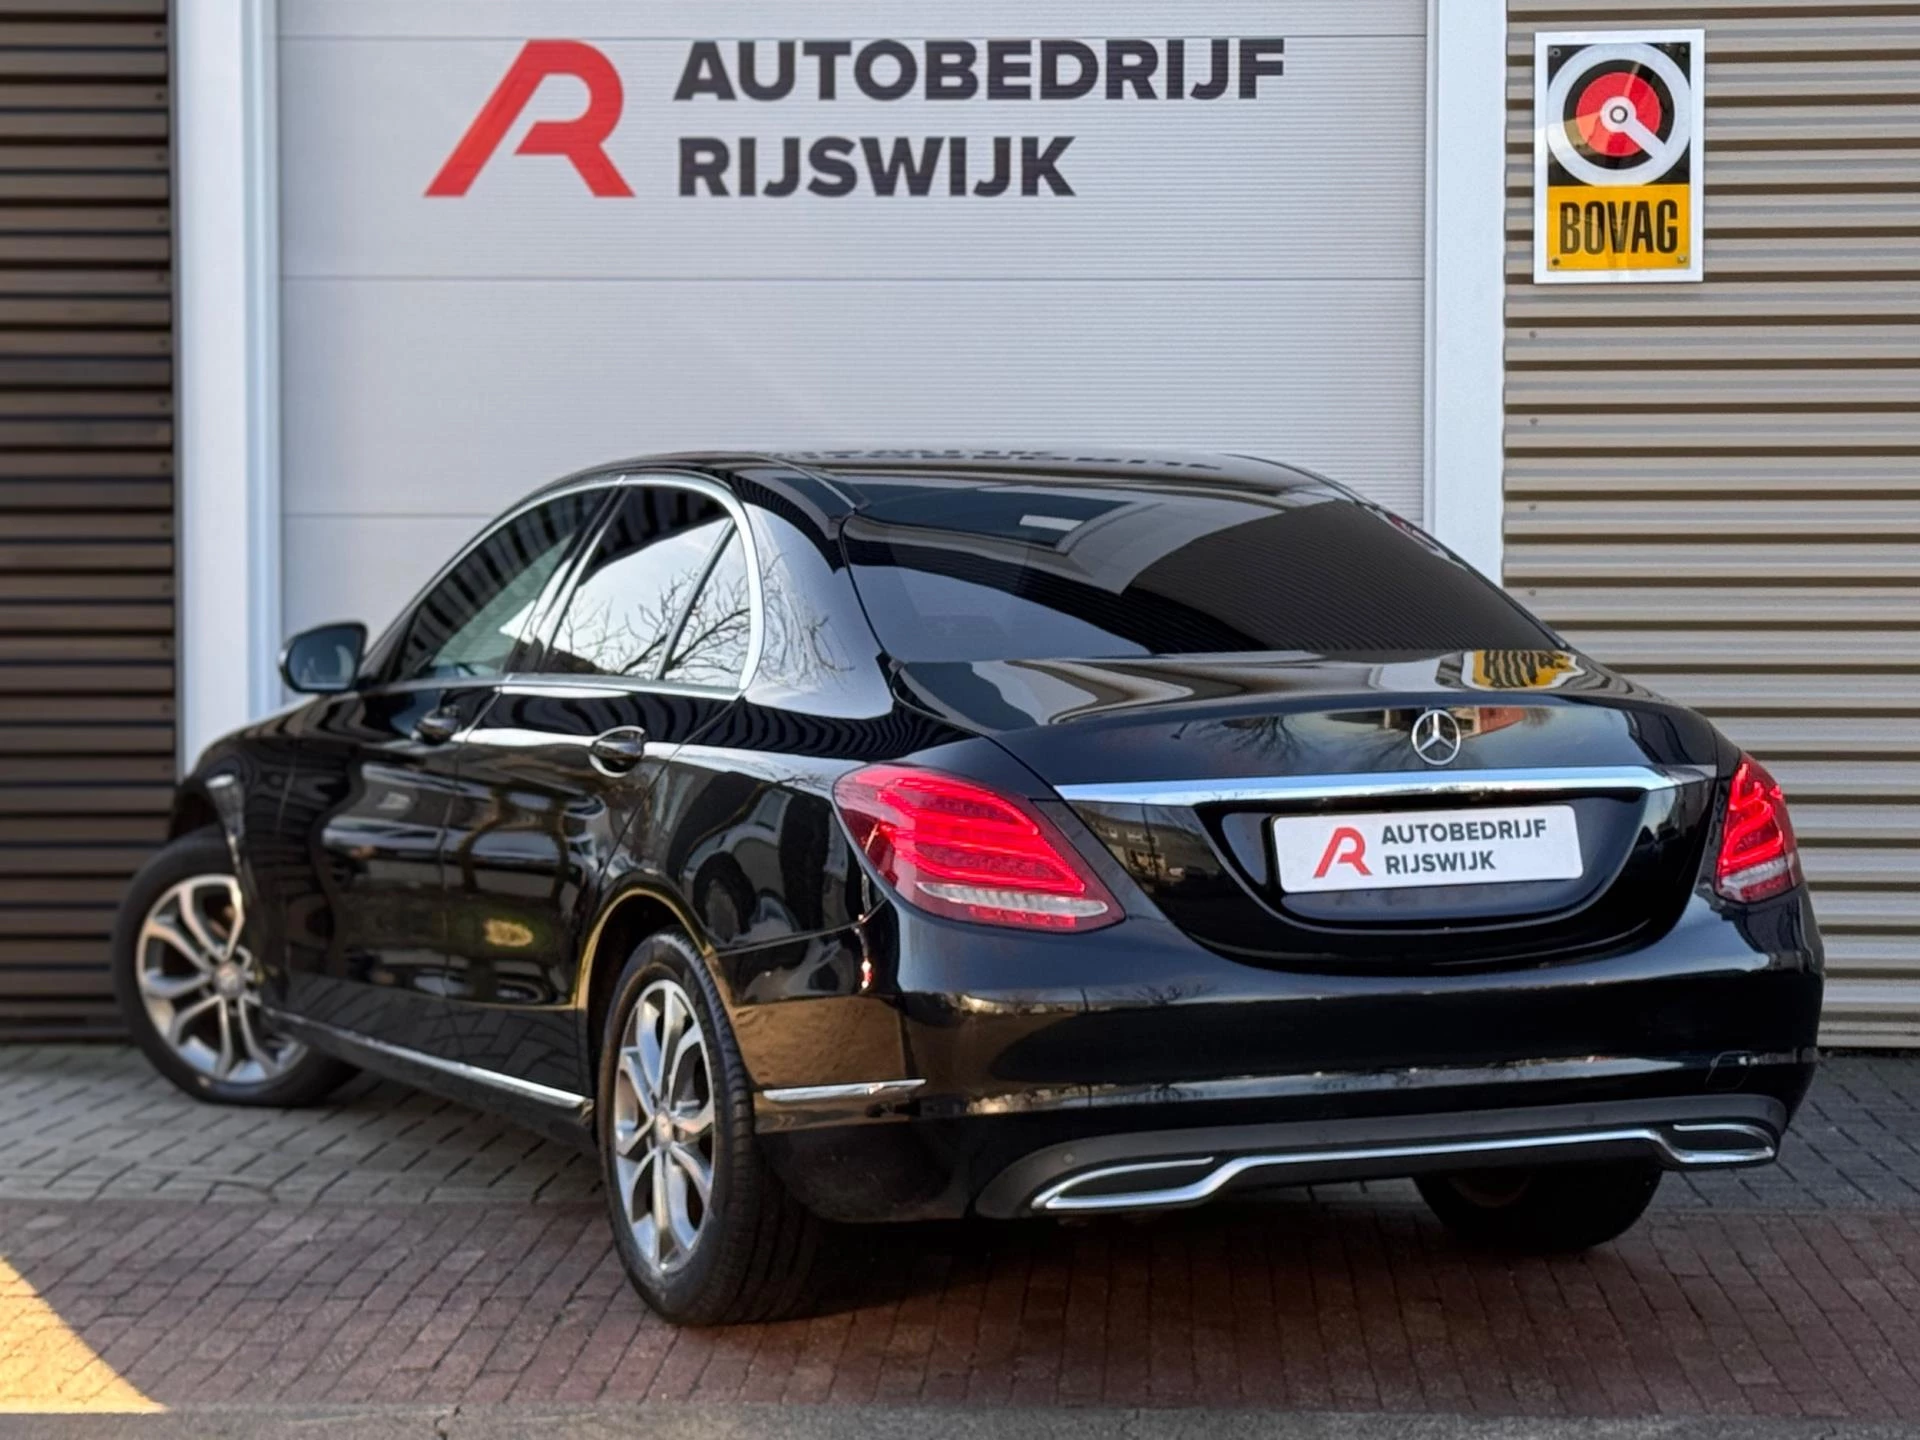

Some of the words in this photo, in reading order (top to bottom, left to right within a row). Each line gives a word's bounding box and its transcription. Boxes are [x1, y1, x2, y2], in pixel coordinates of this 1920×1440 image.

[674, 37, 1285, 101] AUTOBEDRIJF
[678, 135, 1077, 197] RIJSWIJK
[1559, 199, 1679, 255] BOVAG
[1381, 819, 1546, 845] AUTOBEDRIJF
[1386, 850, 1495, 874] RIJSWIJK
